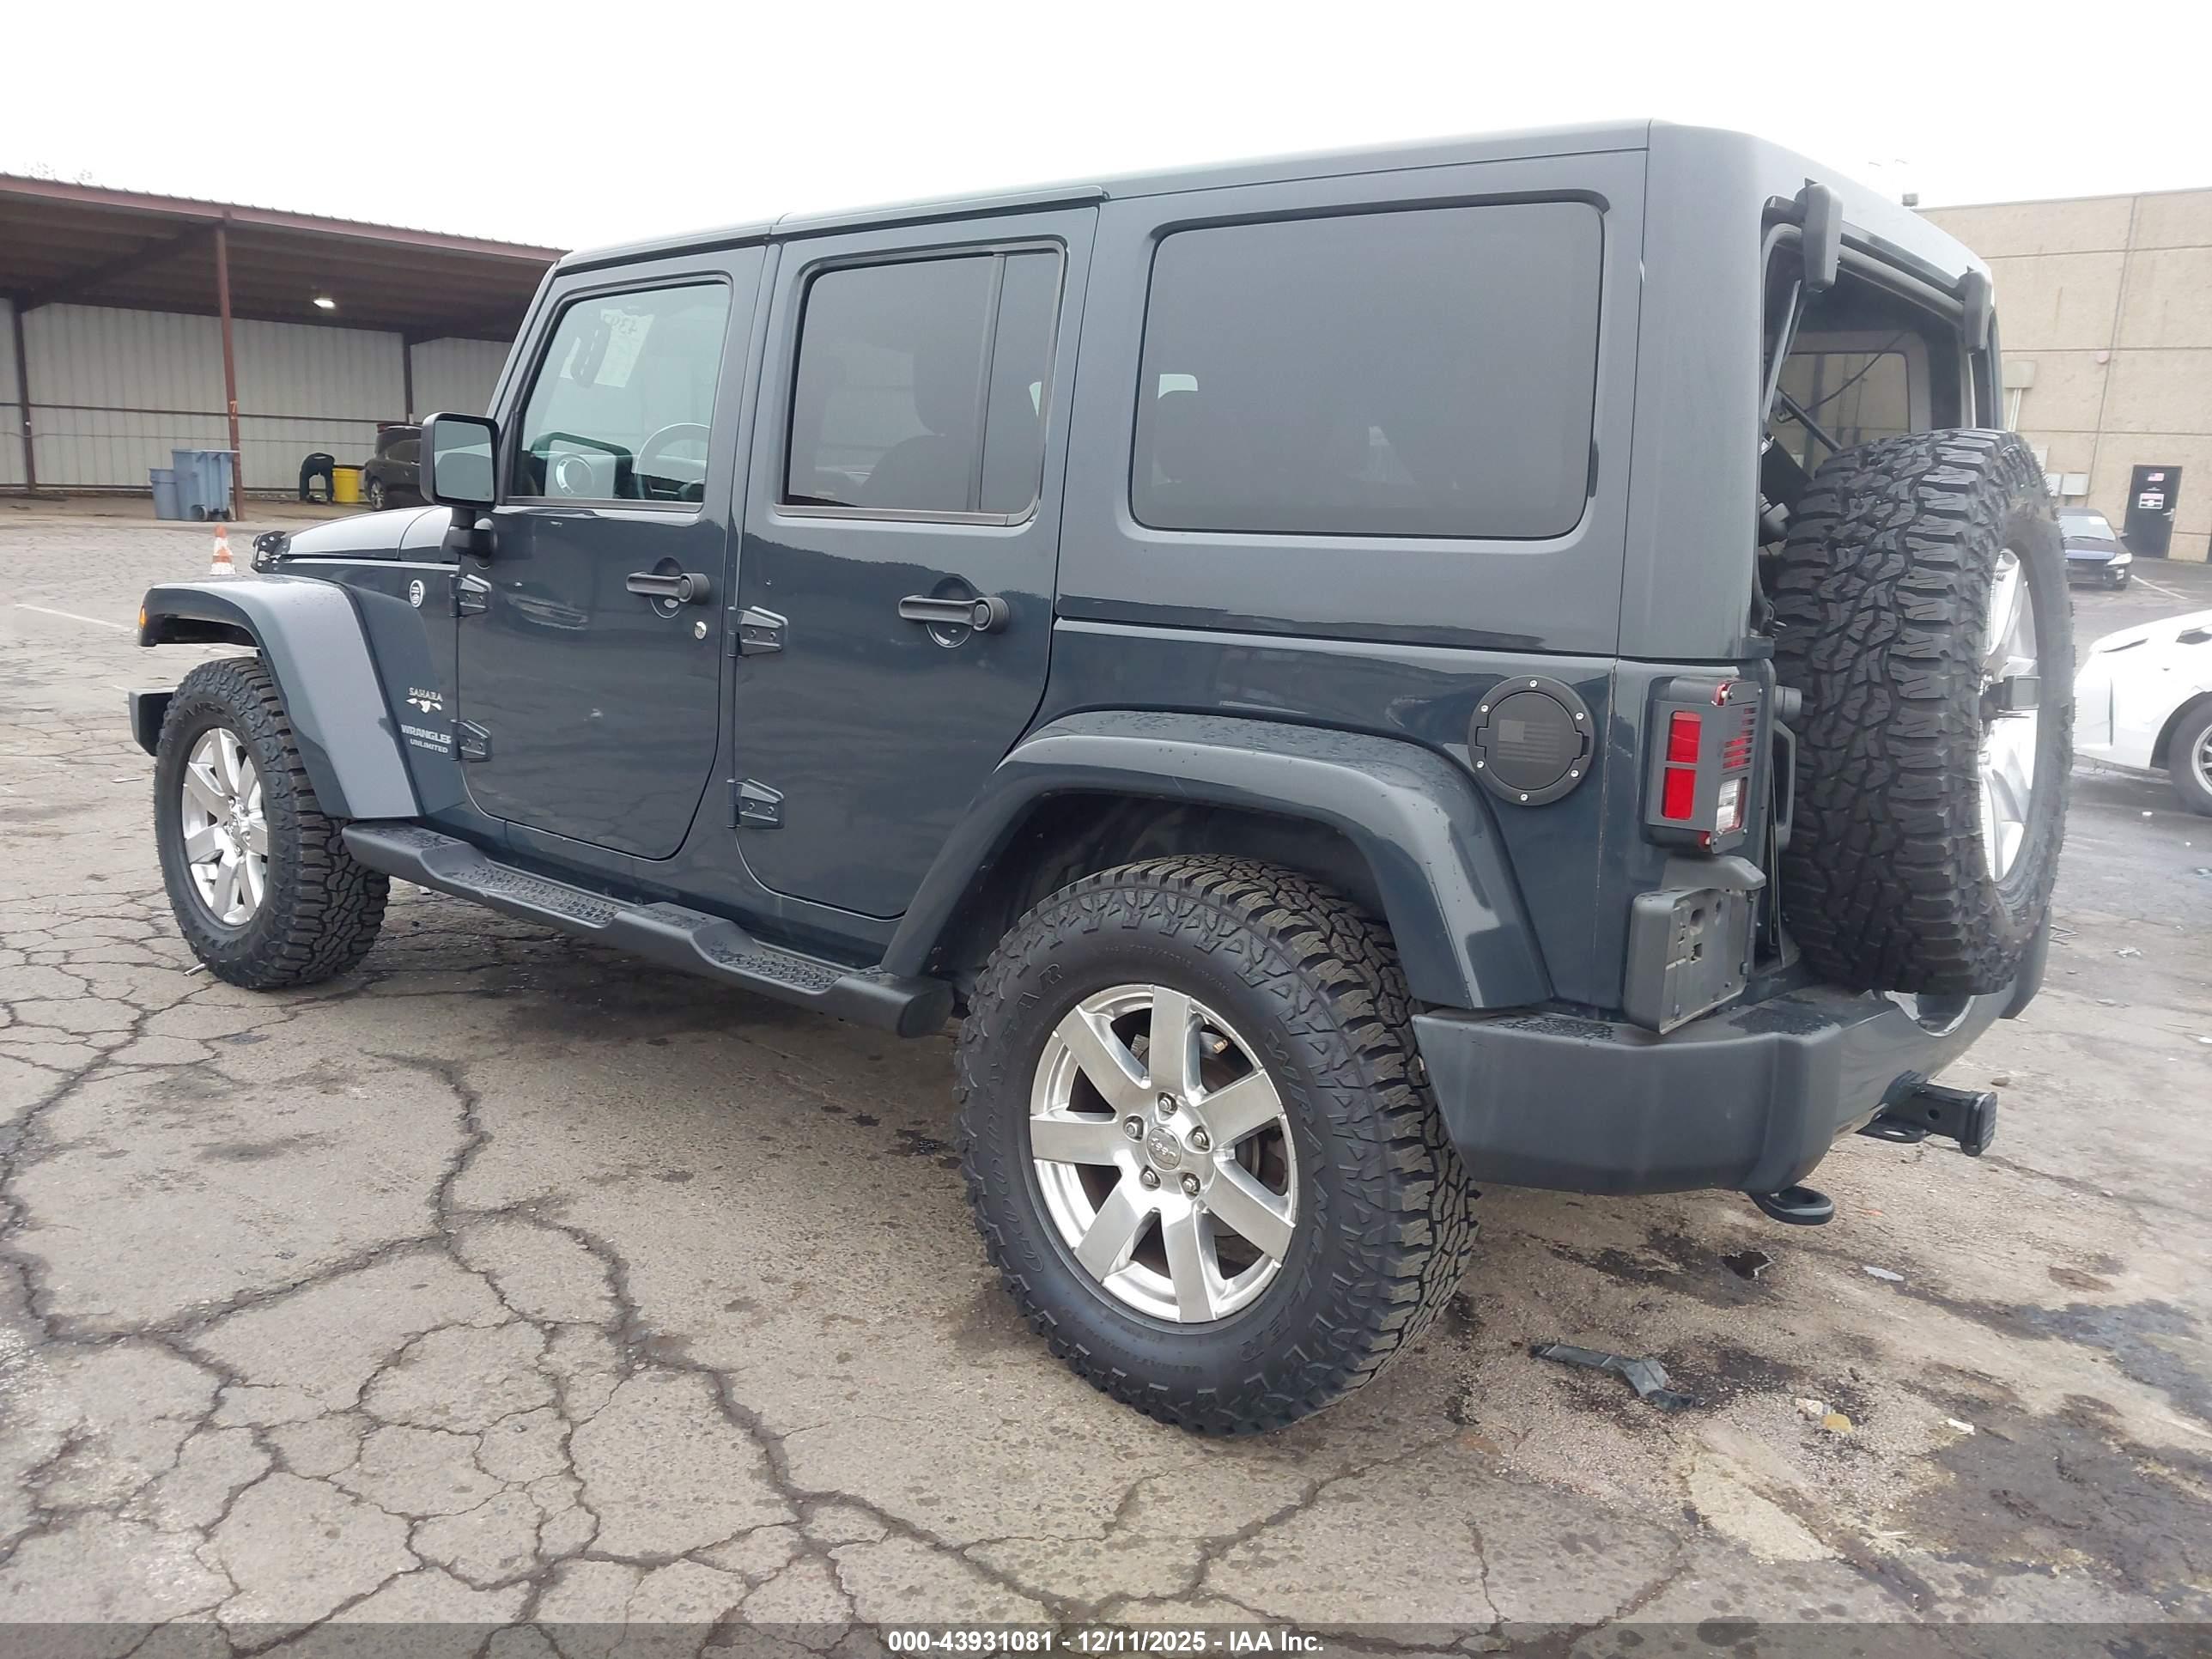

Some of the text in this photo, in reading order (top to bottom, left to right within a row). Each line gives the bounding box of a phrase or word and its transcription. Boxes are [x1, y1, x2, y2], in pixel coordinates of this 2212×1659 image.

[408, 687, 444, 702] SAHARA
[400, 724, 452, 744] WRANGLER
[410, 738, 448, 754] UNLIMITED
